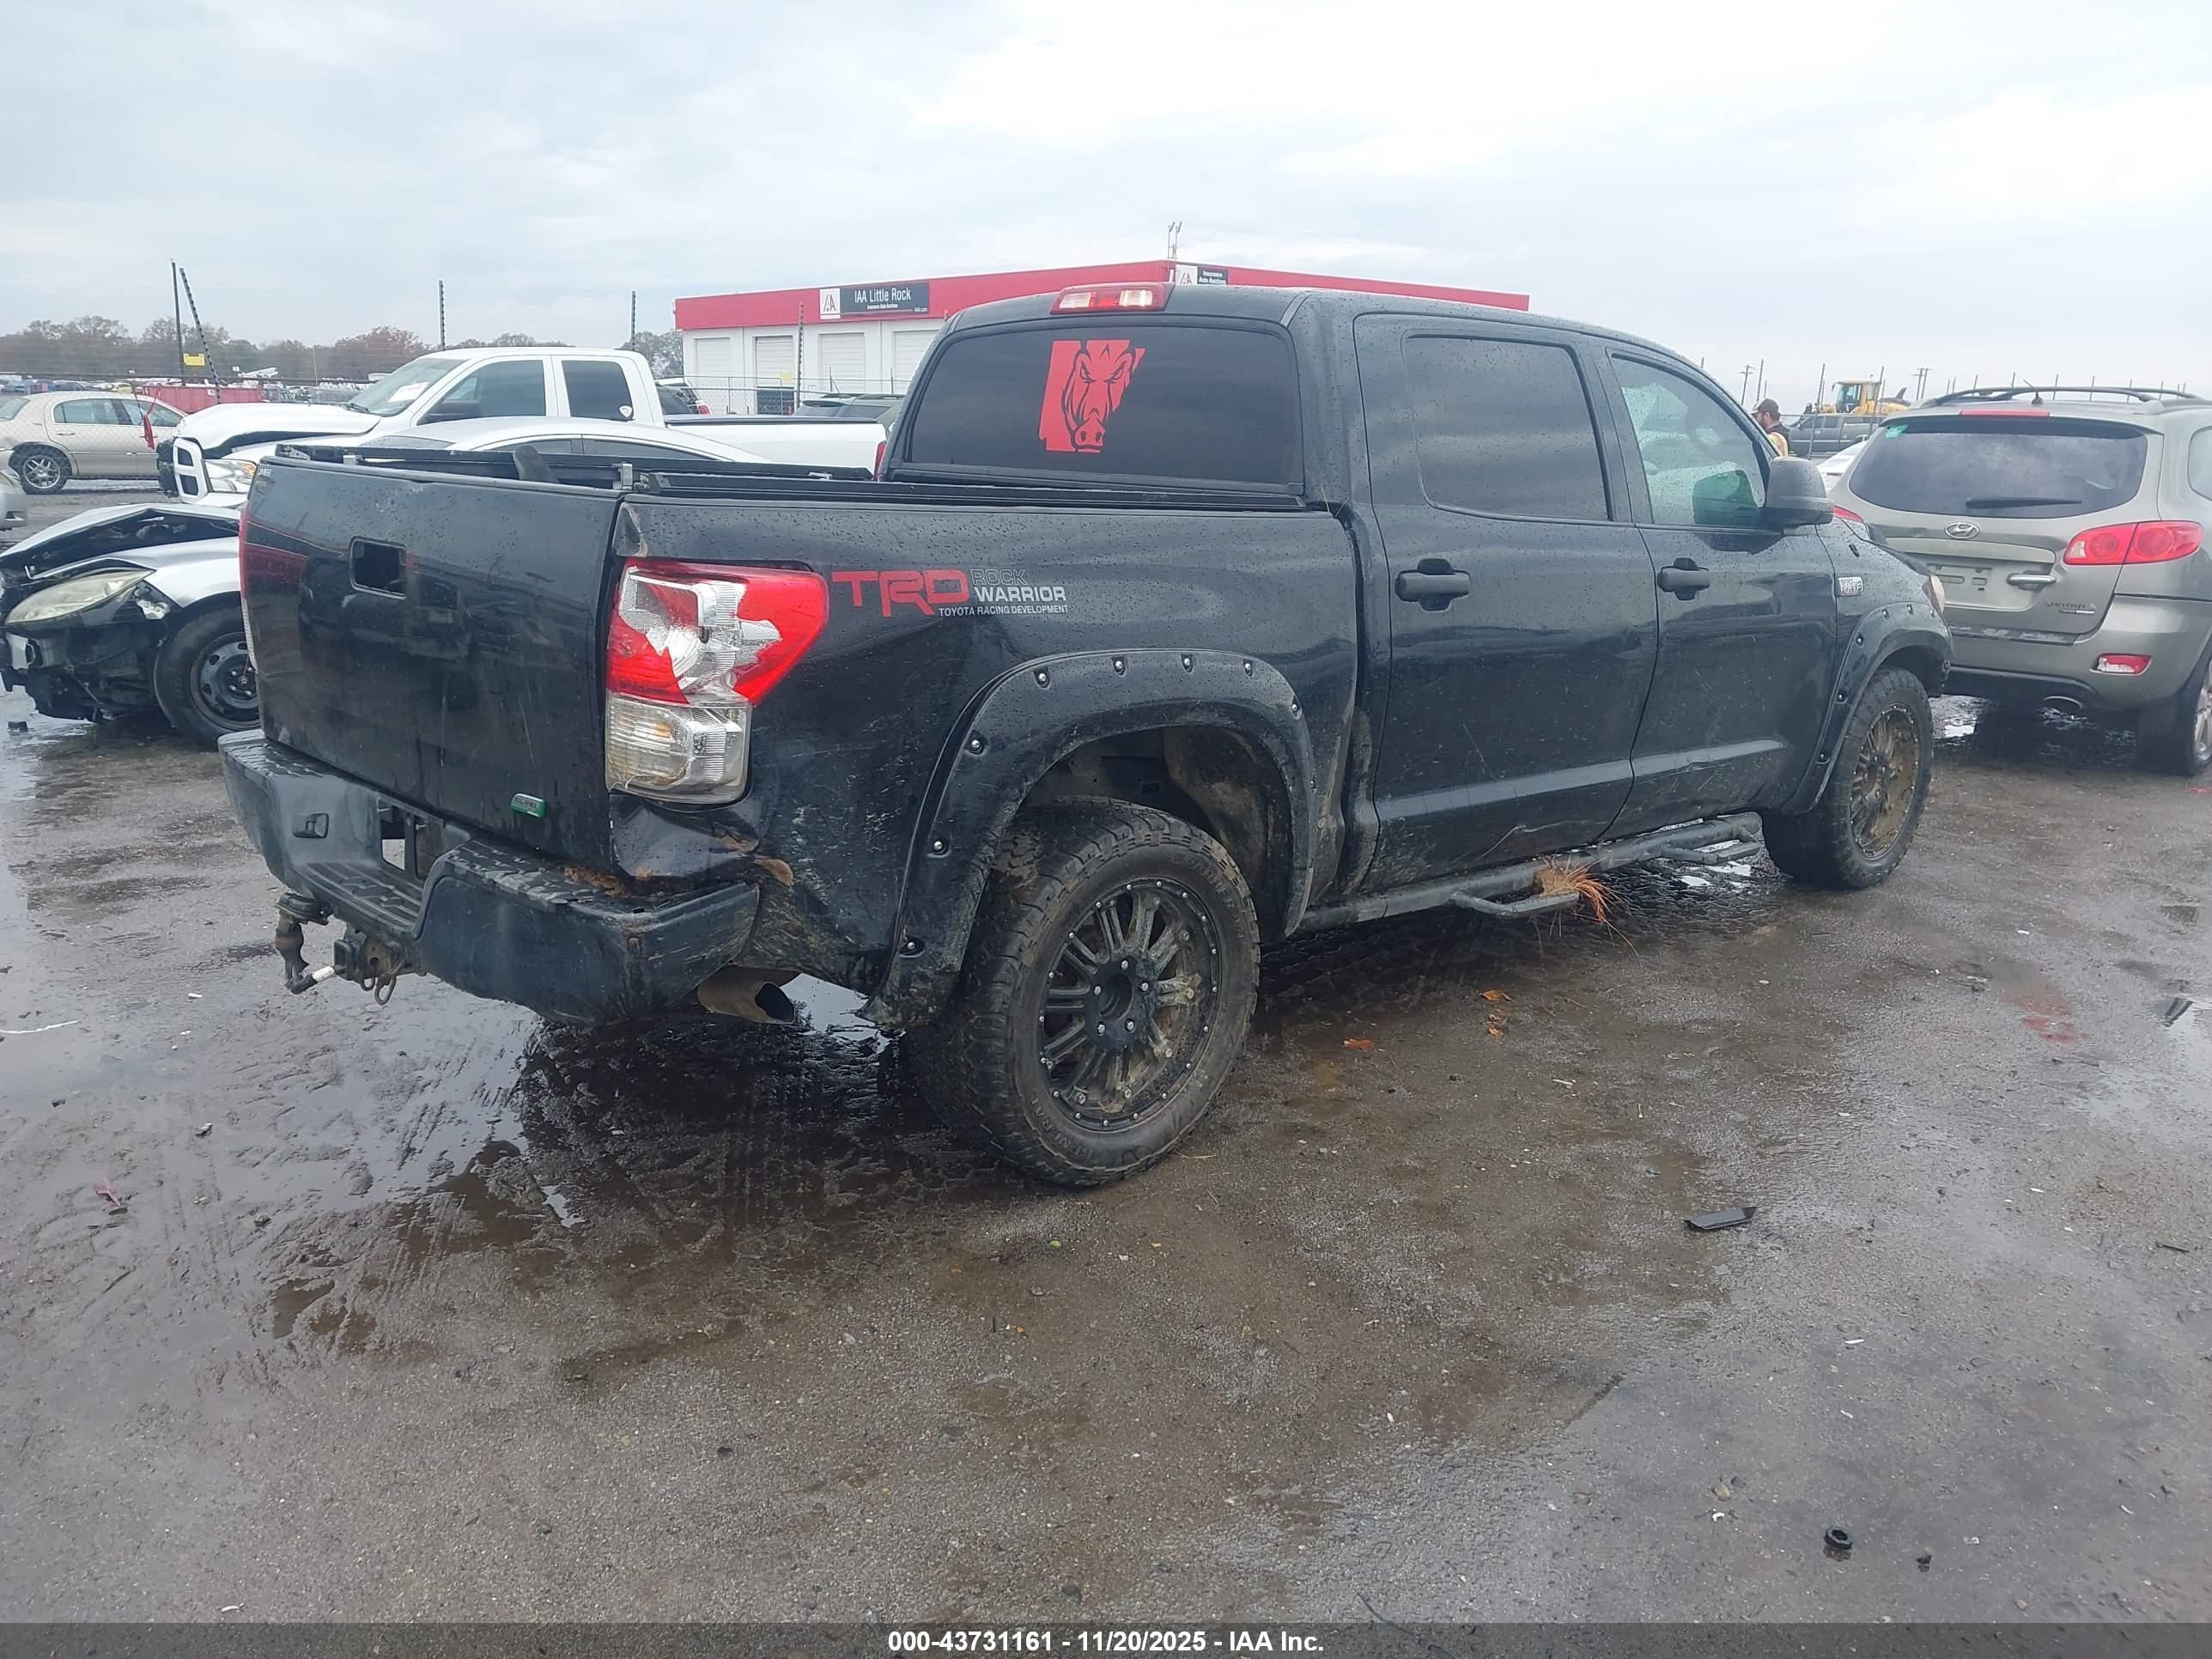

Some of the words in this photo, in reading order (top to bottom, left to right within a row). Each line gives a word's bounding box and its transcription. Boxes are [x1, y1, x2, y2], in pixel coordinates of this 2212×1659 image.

[854, 289, 867, 303] IAA
[869, 288, 890, 302] Little
[891, 286, 912, 301] Rock
[970, 568, 1030, 586] ROCK
[831, 569, 970, 617] TRD
[974, 586, 1066, 602] WARRIOR
[939, 606, 975, 617] TOYOTA
[976, 605, 1010, 616] RACING
[1012, 604, 1069, 615] DEVELOPMENT
